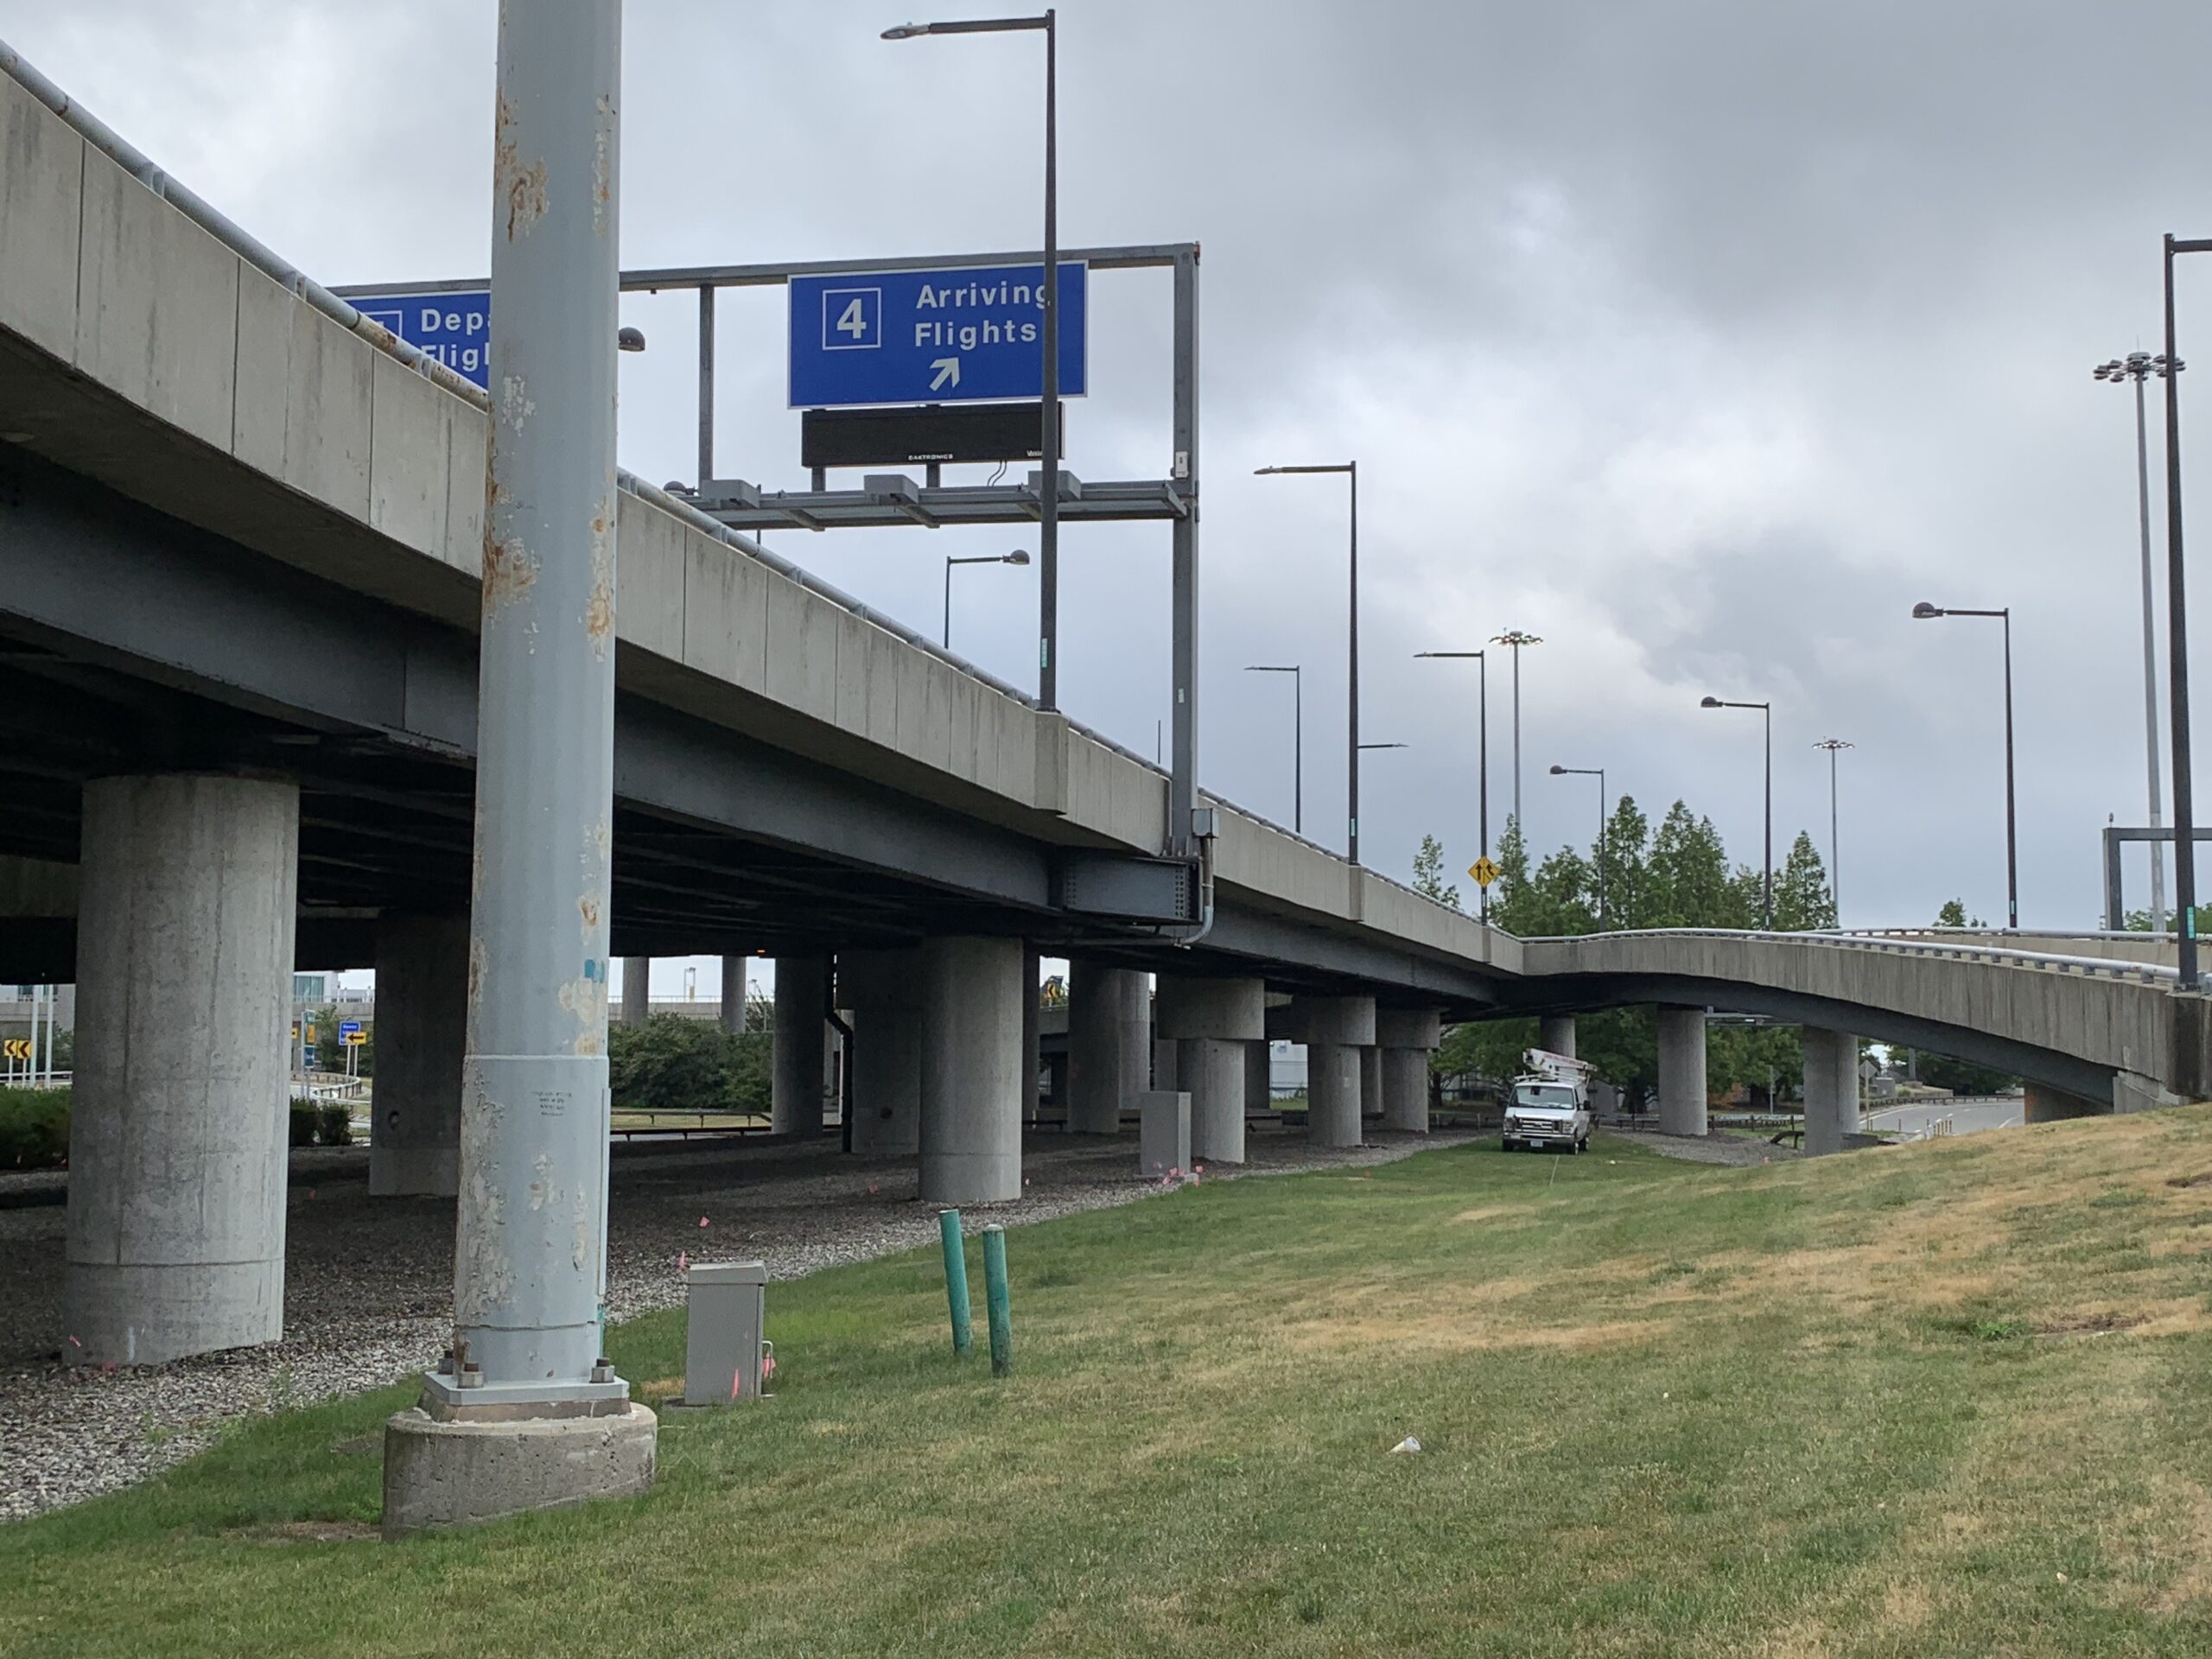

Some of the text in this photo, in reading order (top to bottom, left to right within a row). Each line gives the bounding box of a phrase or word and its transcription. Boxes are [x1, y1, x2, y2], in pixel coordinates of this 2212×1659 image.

[421, 308, 491, 336] Dep
[836, 298, 868, 340] 4
[914, 320, 1038, 351] Flights
